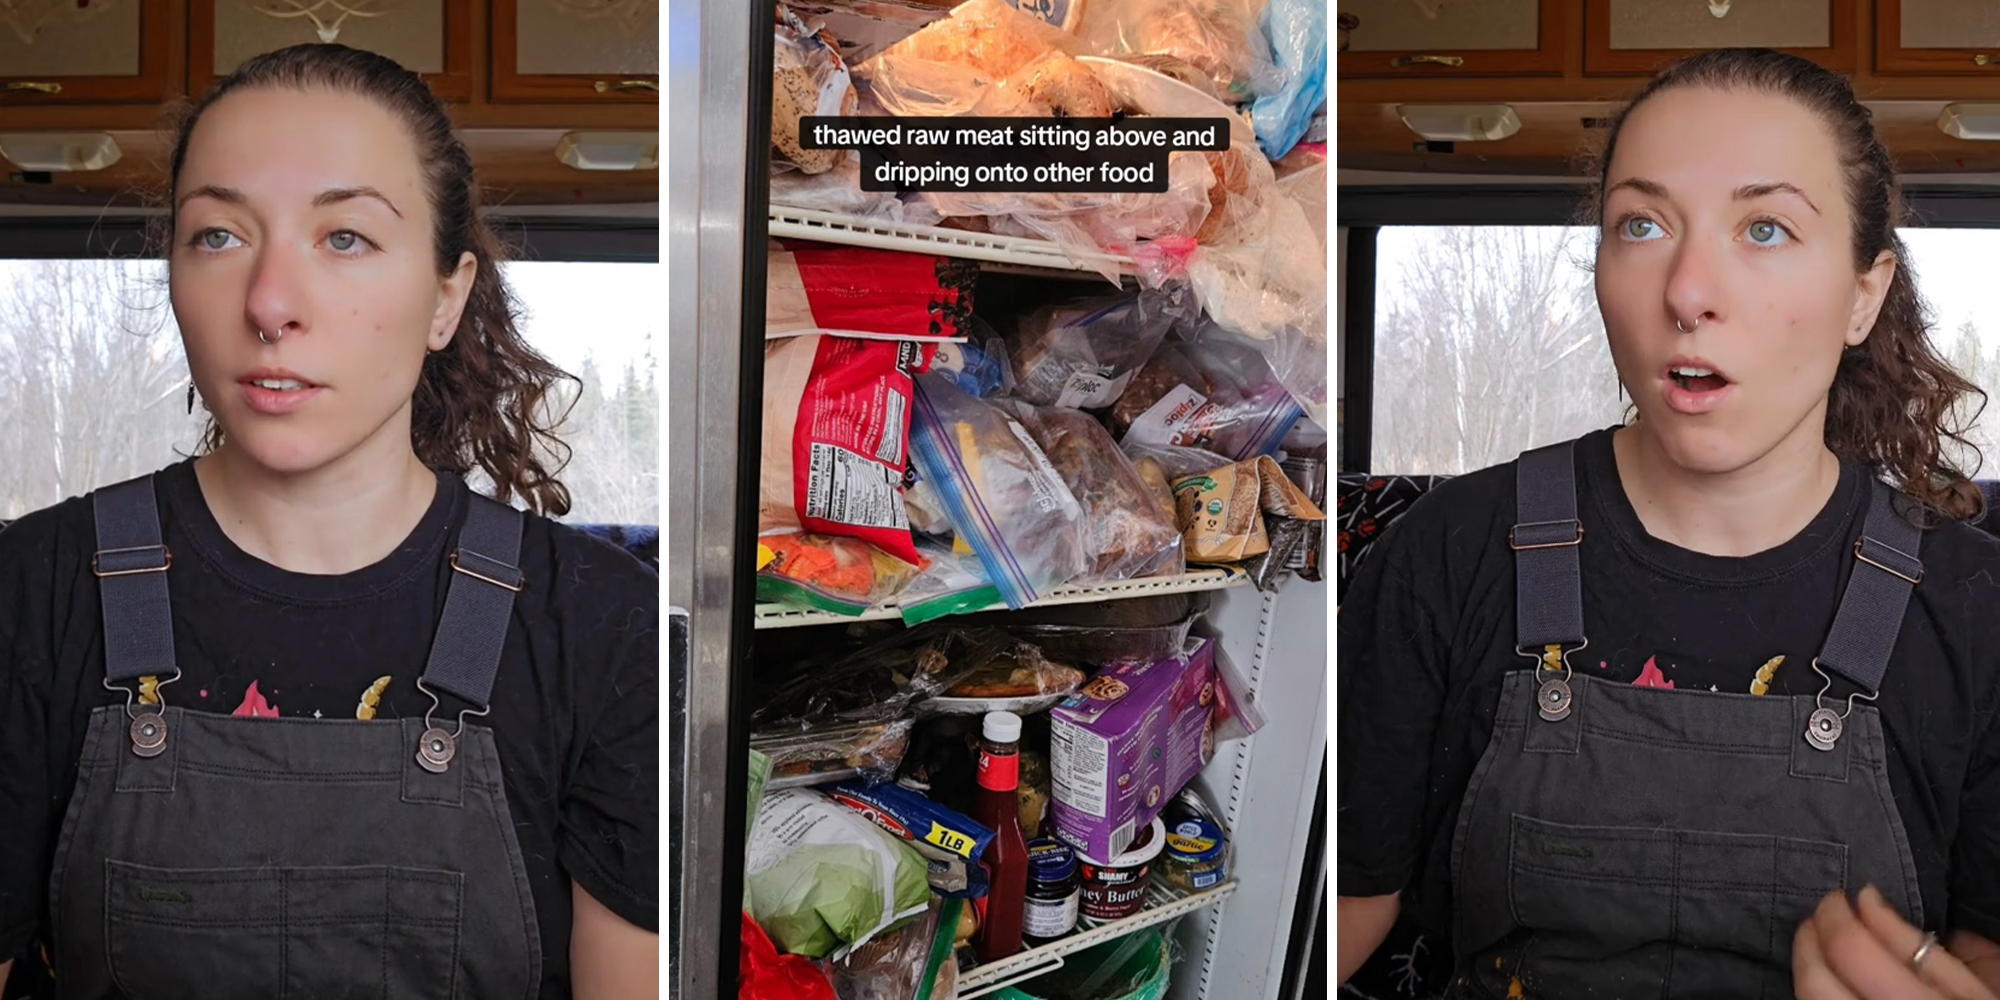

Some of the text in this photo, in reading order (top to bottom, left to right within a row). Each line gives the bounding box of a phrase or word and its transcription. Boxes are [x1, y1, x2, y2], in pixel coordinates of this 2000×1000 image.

[1070, 377, 1101, 393] Ziploc
[1165, 397, 1198, 427] Ziploc
[808, 444, 820, 516] Nutrition Facts
[835, 448, 845, 521] Calories 60
[1173, 838, 1205, 850] garlic
[1097, 871, 1129, 881] SHAMY
[1107, 884, 1146, 903] Butter
